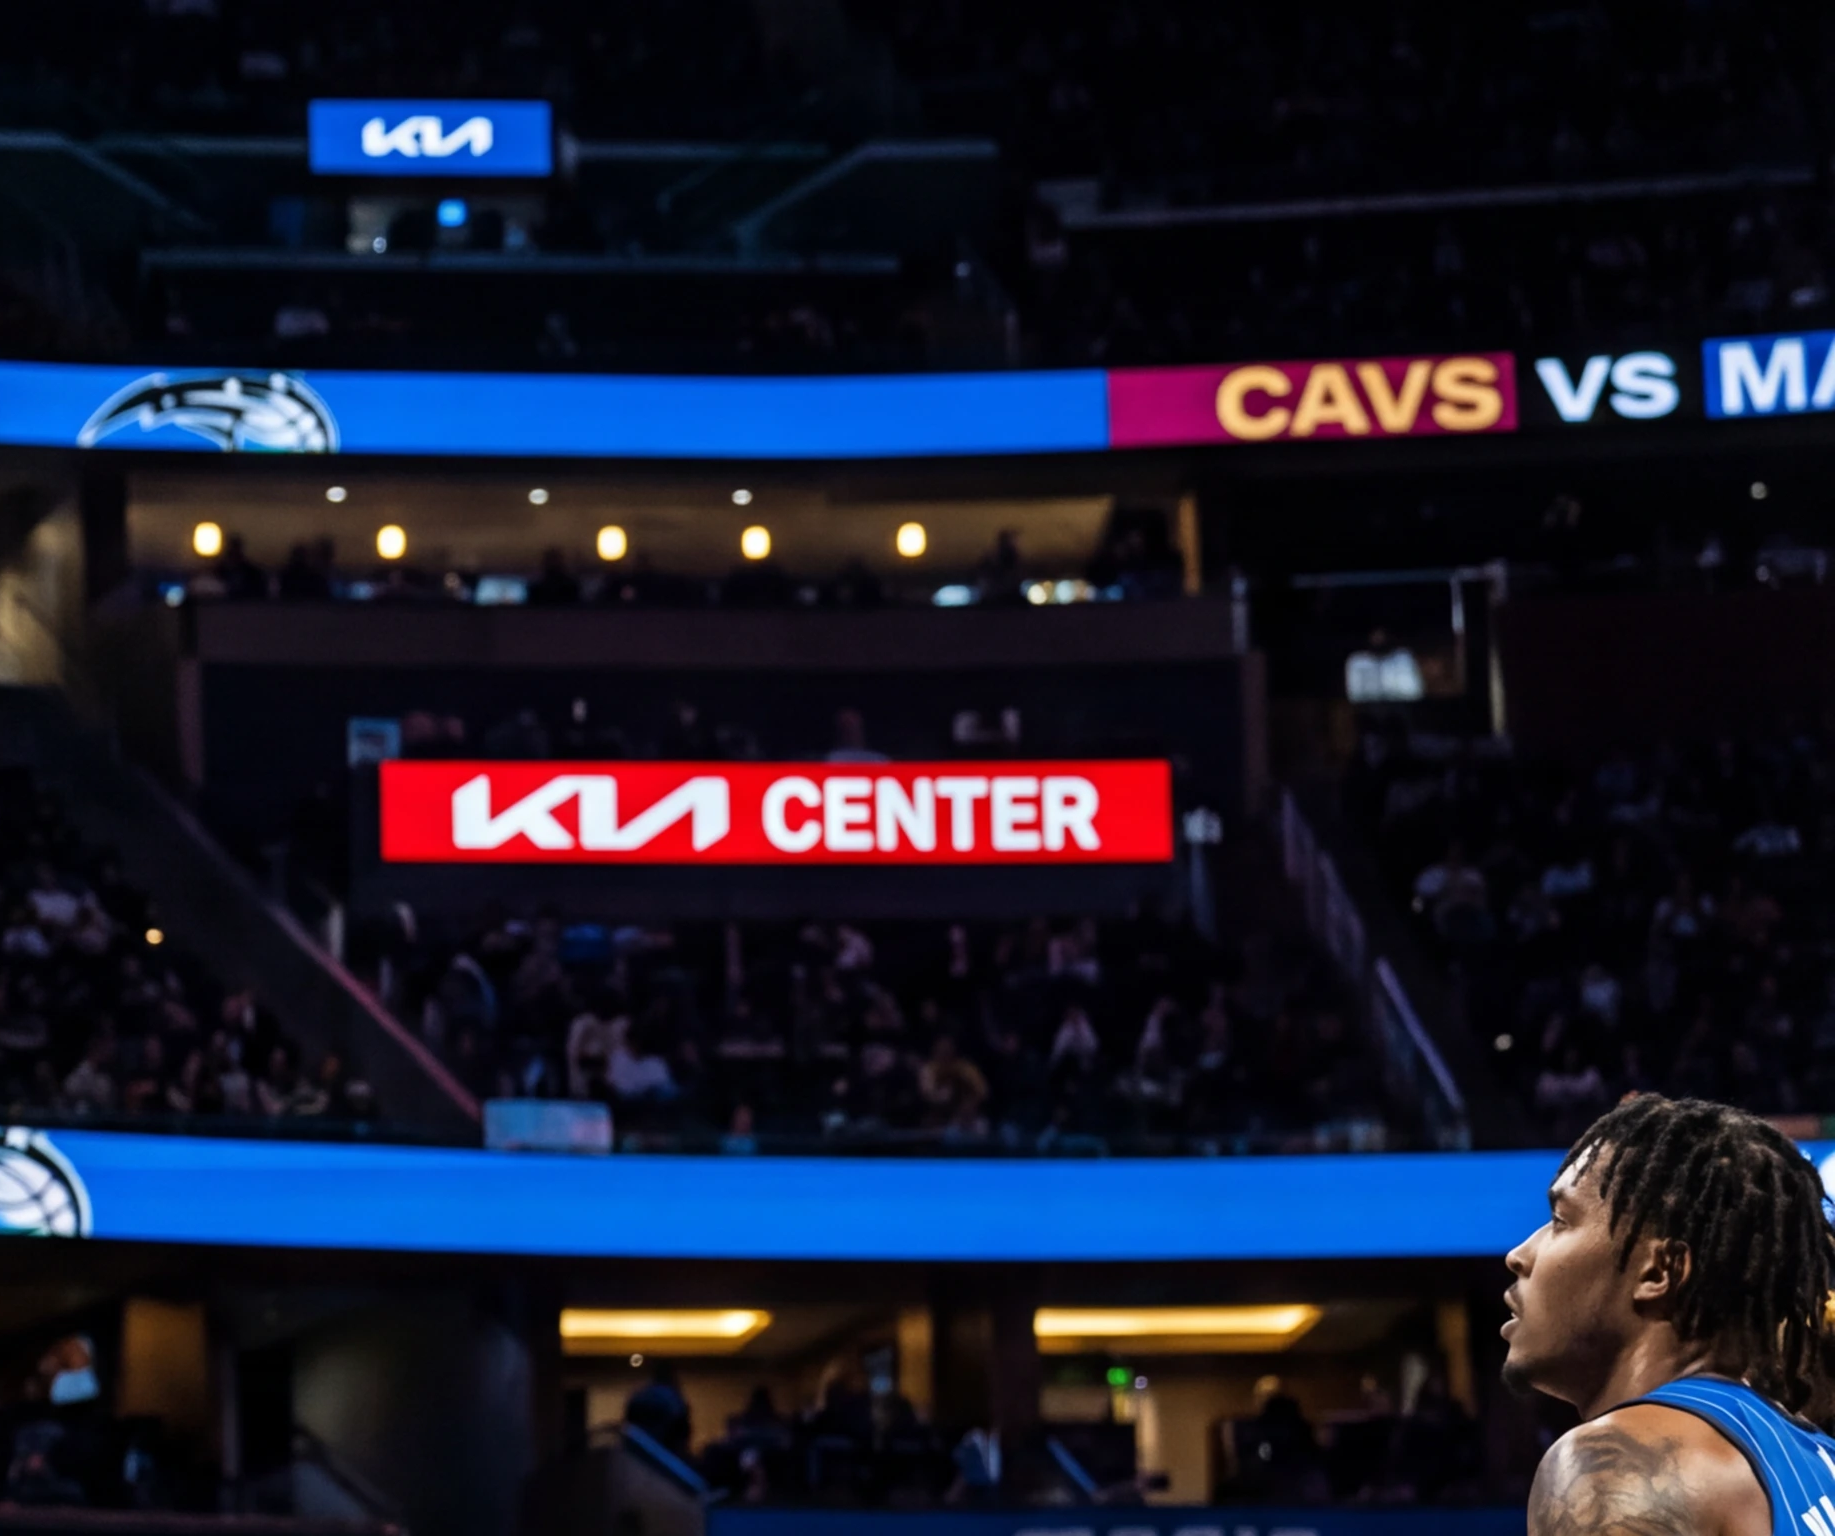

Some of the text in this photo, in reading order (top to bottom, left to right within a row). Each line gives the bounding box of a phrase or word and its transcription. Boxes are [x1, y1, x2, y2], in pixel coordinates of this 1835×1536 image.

[1215, 357, 1503, 441] CAVS
[1536, 352, 1679, 421] VS
[761, 776, 1101, 853] CENTER
